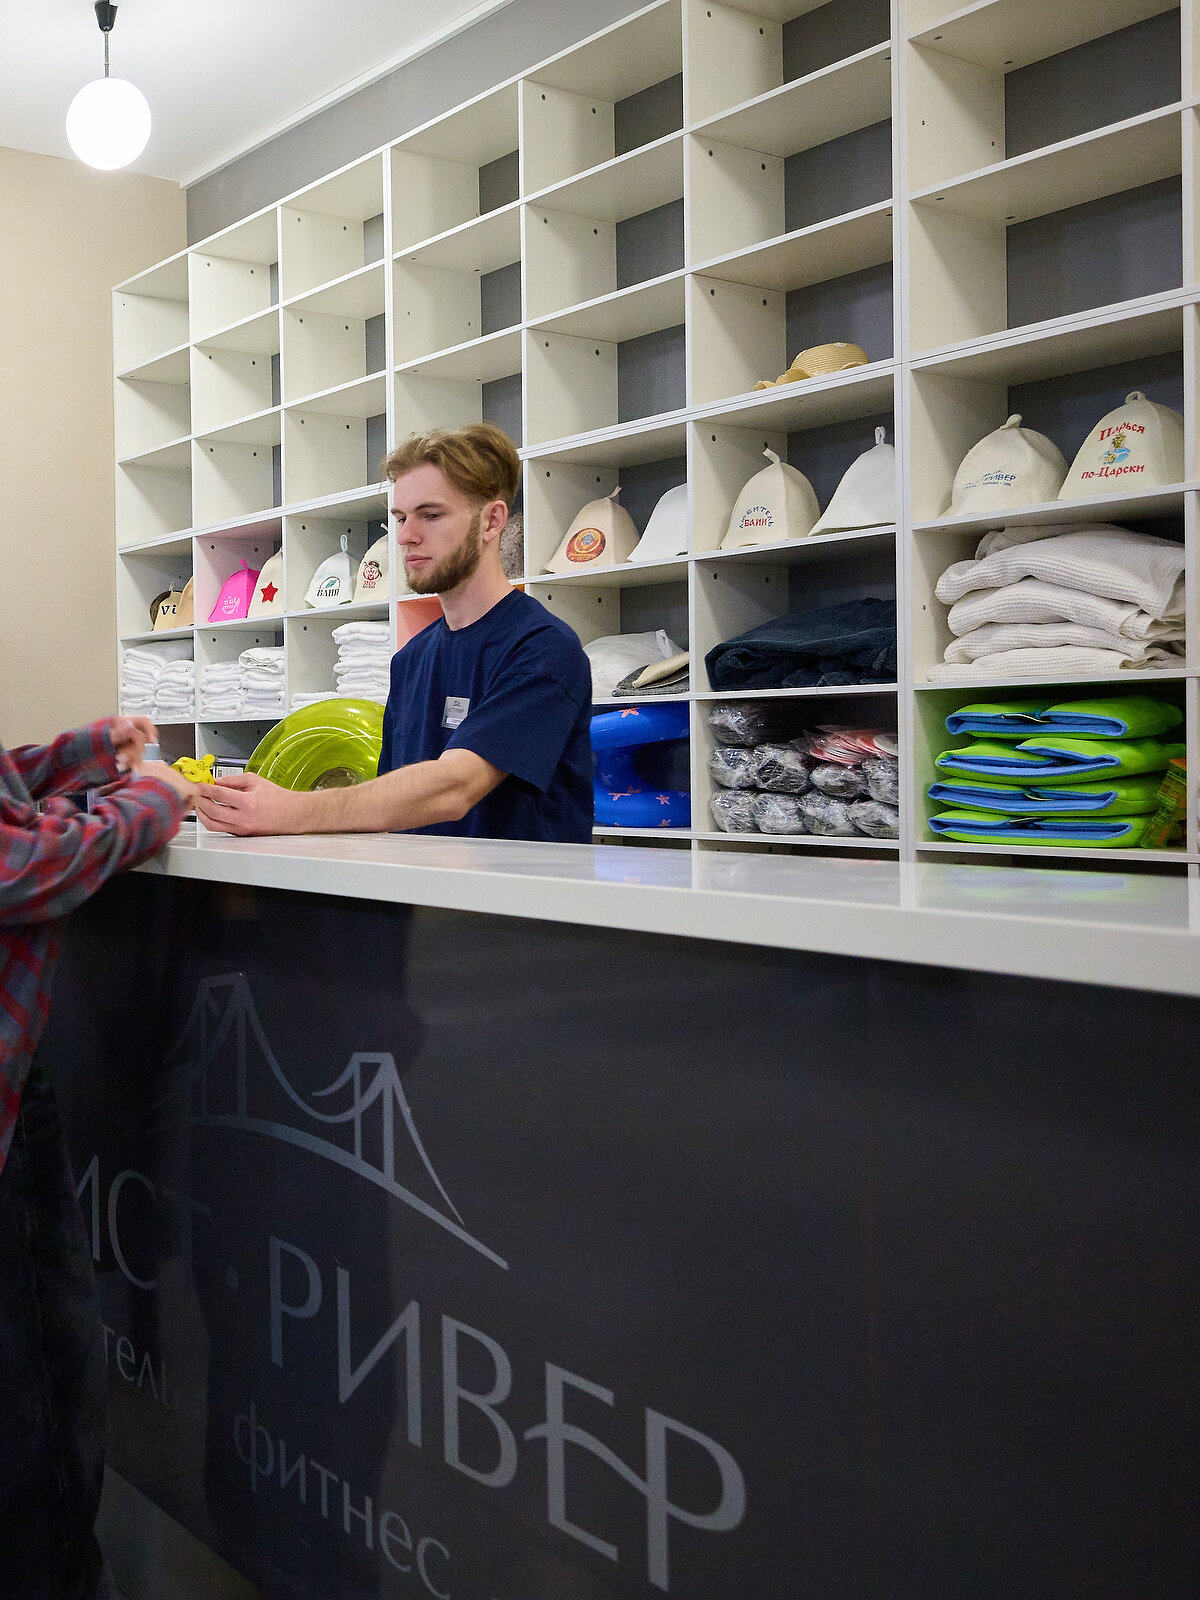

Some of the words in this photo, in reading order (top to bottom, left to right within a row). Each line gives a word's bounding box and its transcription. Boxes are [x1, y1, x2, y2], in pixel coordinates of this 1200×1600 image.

[1081, 465, 1144, 480] по-Царски
[1098, 422, 1145, 441] Парься
[268, 1235, 747, 1592] РИВЕР
[233, 1402, 451, 1600] фитнес
